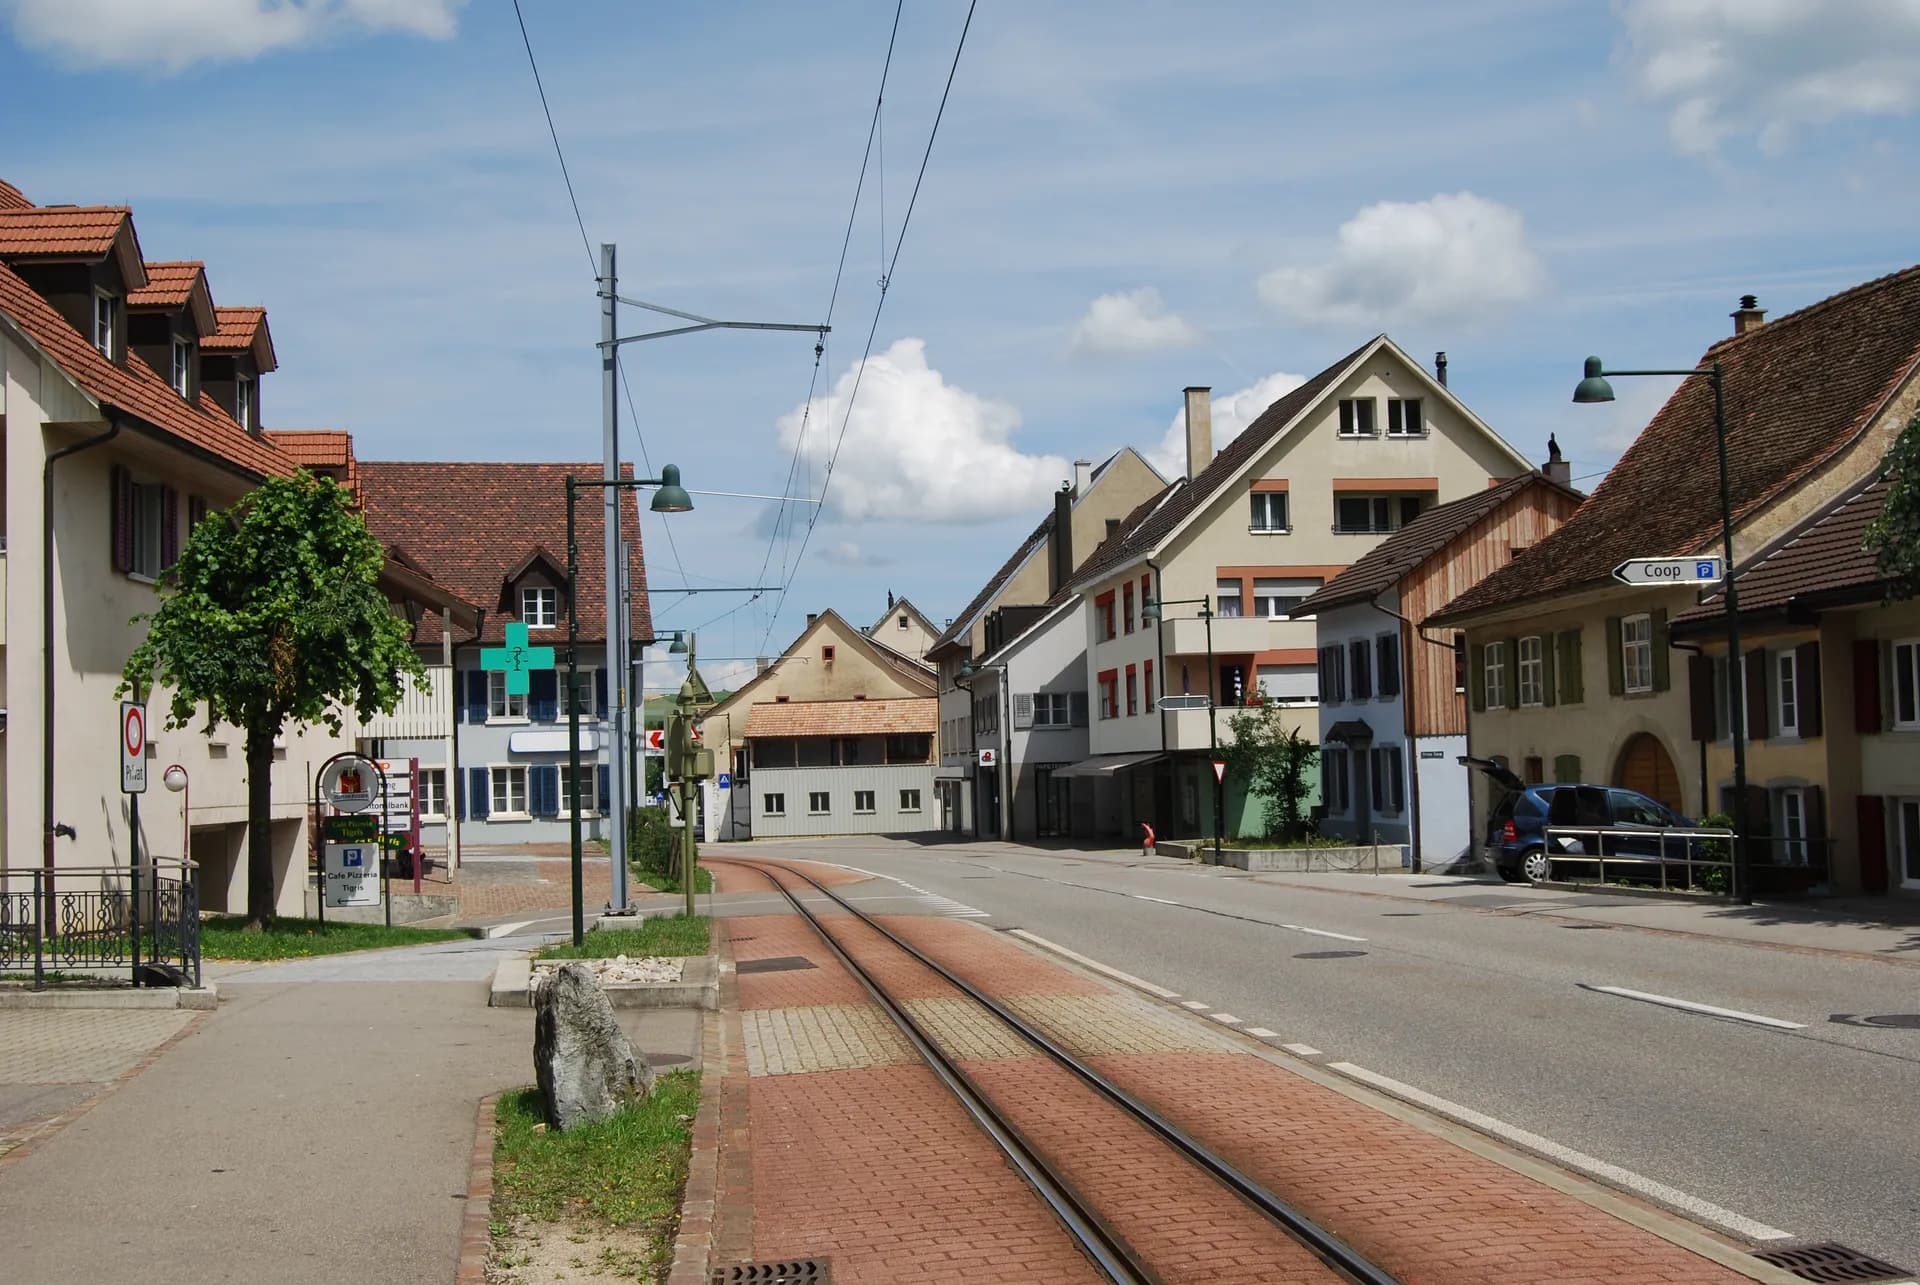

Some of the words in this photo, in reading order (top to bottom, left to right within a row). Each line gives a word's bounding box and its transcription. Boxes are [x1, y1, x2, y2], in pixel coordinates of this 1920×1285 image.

[1644, 564, 1681, 579] Coop
[126, 765, 143, 781] Privat
[342, 828, 364, 838] Tigris
[328, 872, 346, 880] Cafe
[347, 872, 378, 880] Pizzeria
[342, 884, 364, 893] Tigris
